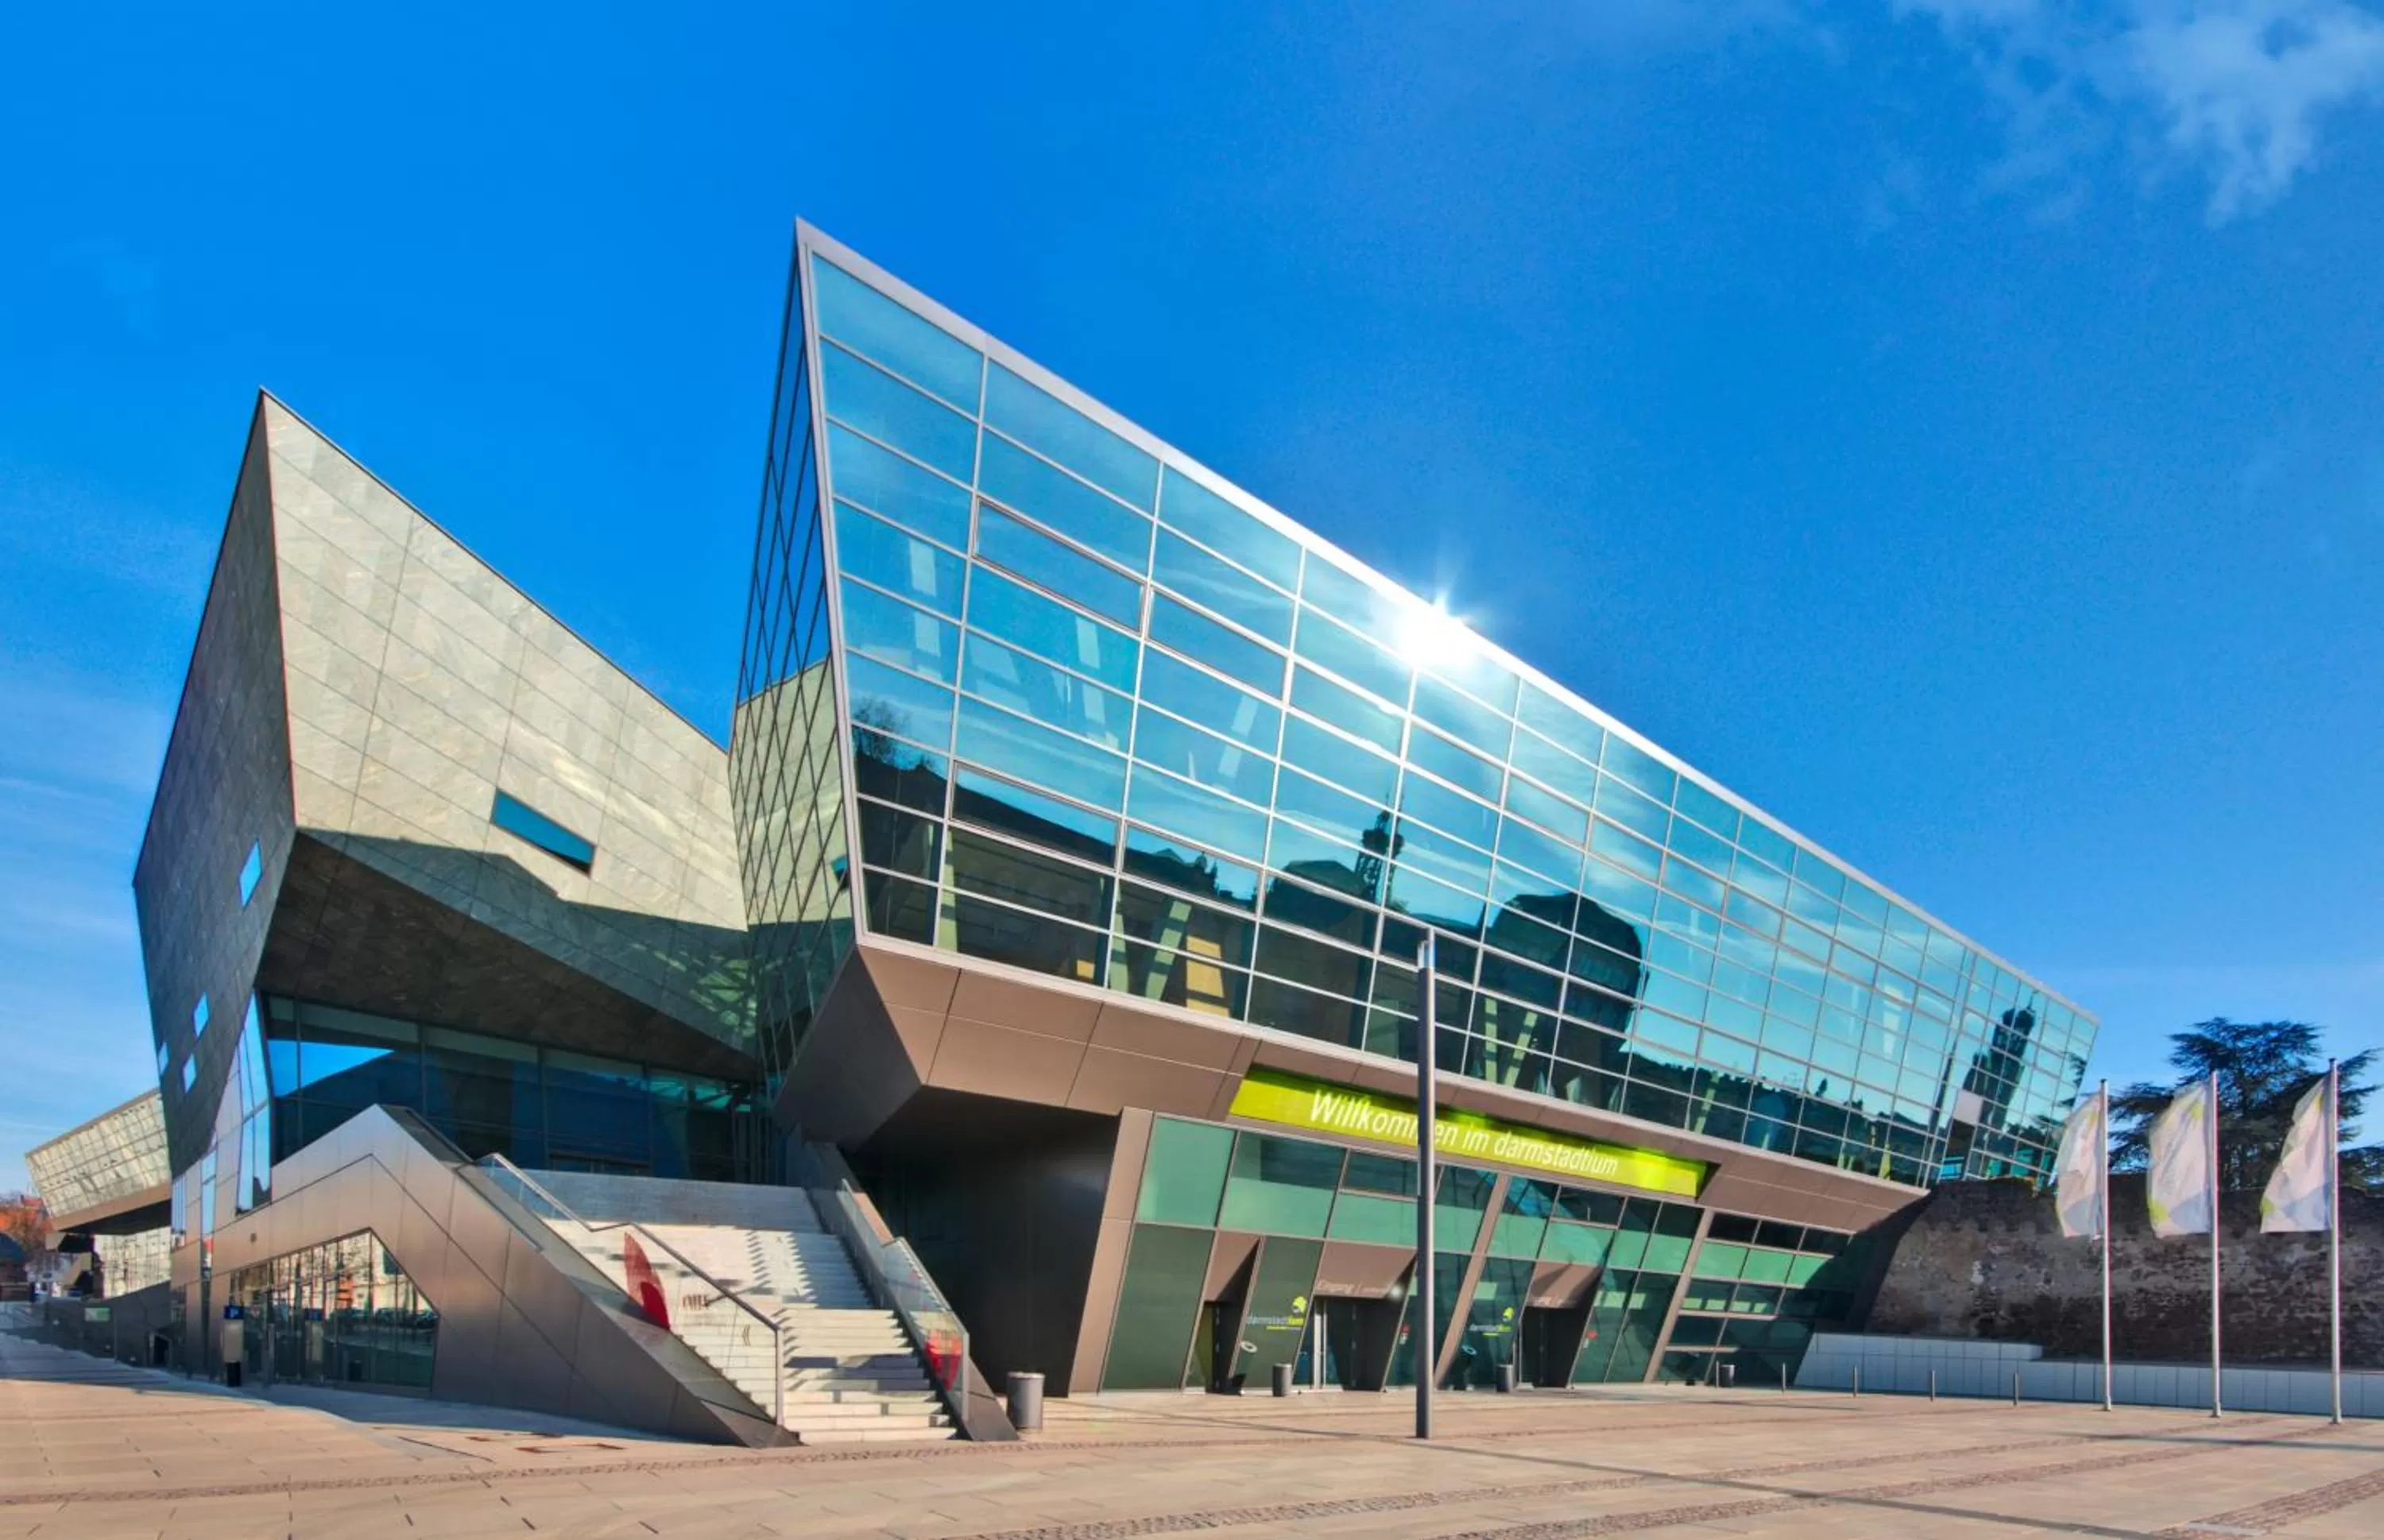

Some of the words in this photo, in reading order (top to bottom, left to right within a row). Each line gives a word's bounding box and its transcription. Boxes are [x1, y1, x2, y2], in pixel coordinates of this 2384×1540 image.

[1310, 1089, 1459, 1146] Willkomen
[1463, 1123, 1490, 1152] im
[1494, 1131, 1619, 1176] darmstadtium
